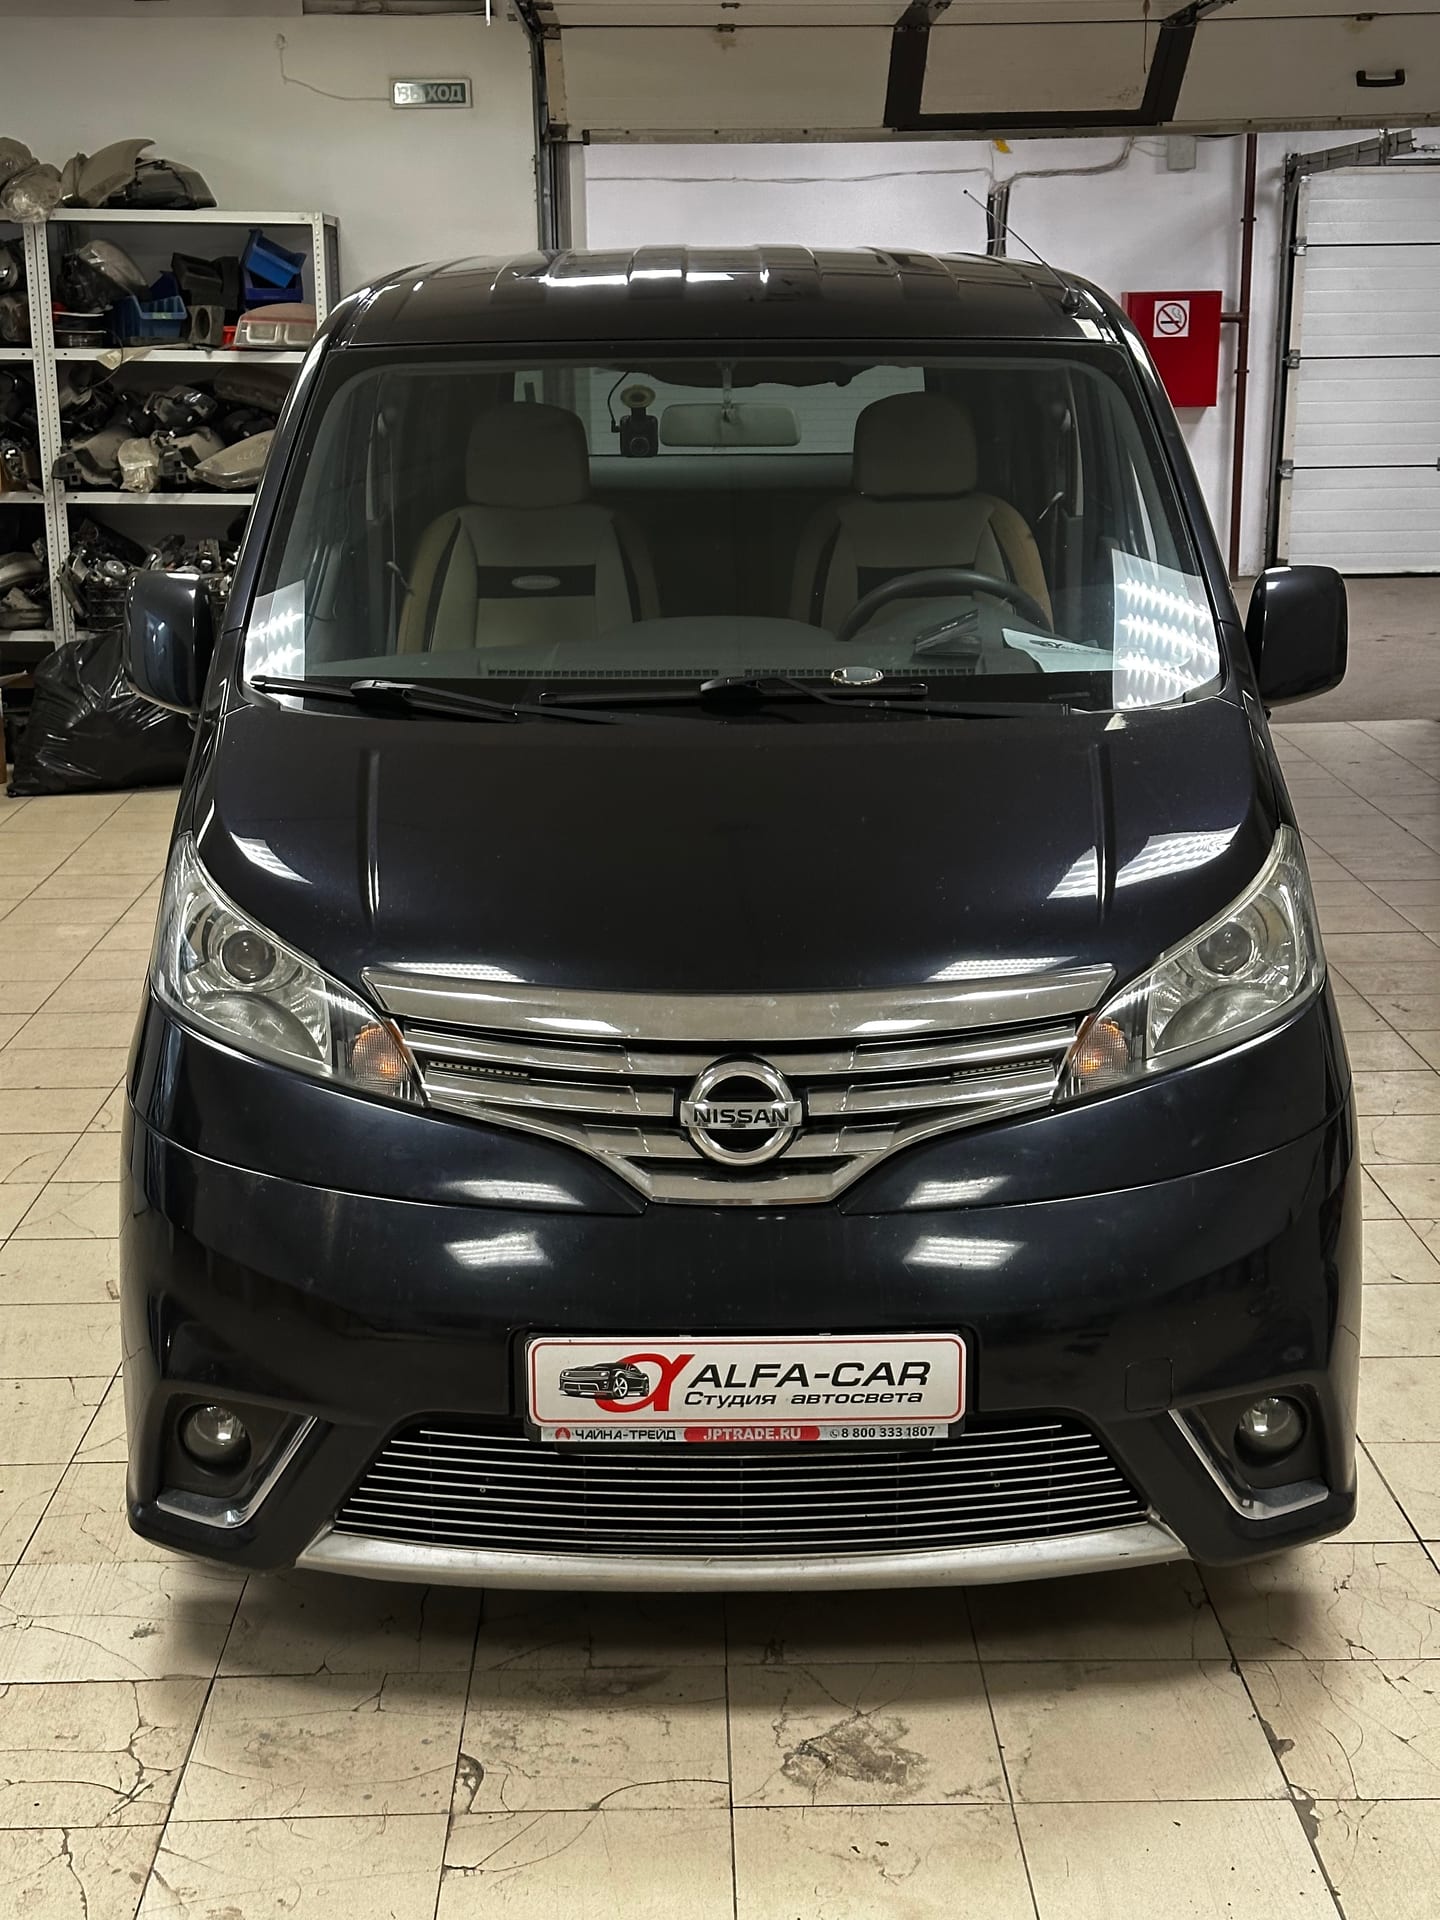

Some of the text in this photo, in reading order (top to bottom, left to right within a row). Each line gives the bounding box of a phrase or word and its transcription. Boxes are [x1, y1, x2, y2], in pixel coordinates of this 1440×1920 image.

[397, 85, 463, 102] ВЫХОД
[693, 1107, 789, 1124] NISSAN
[687, 1361, 931, 1389] ALFA-CAR
[684, 1391, 923, 1409] Студия автосвета
[575, 1428, 676, 1441] ЧАЙНА-ТРЕЙД
[703, 1427, 801, 1441] JPTRADE.RU
[841, 1426, 936, 1438] 8 800 333 1807
